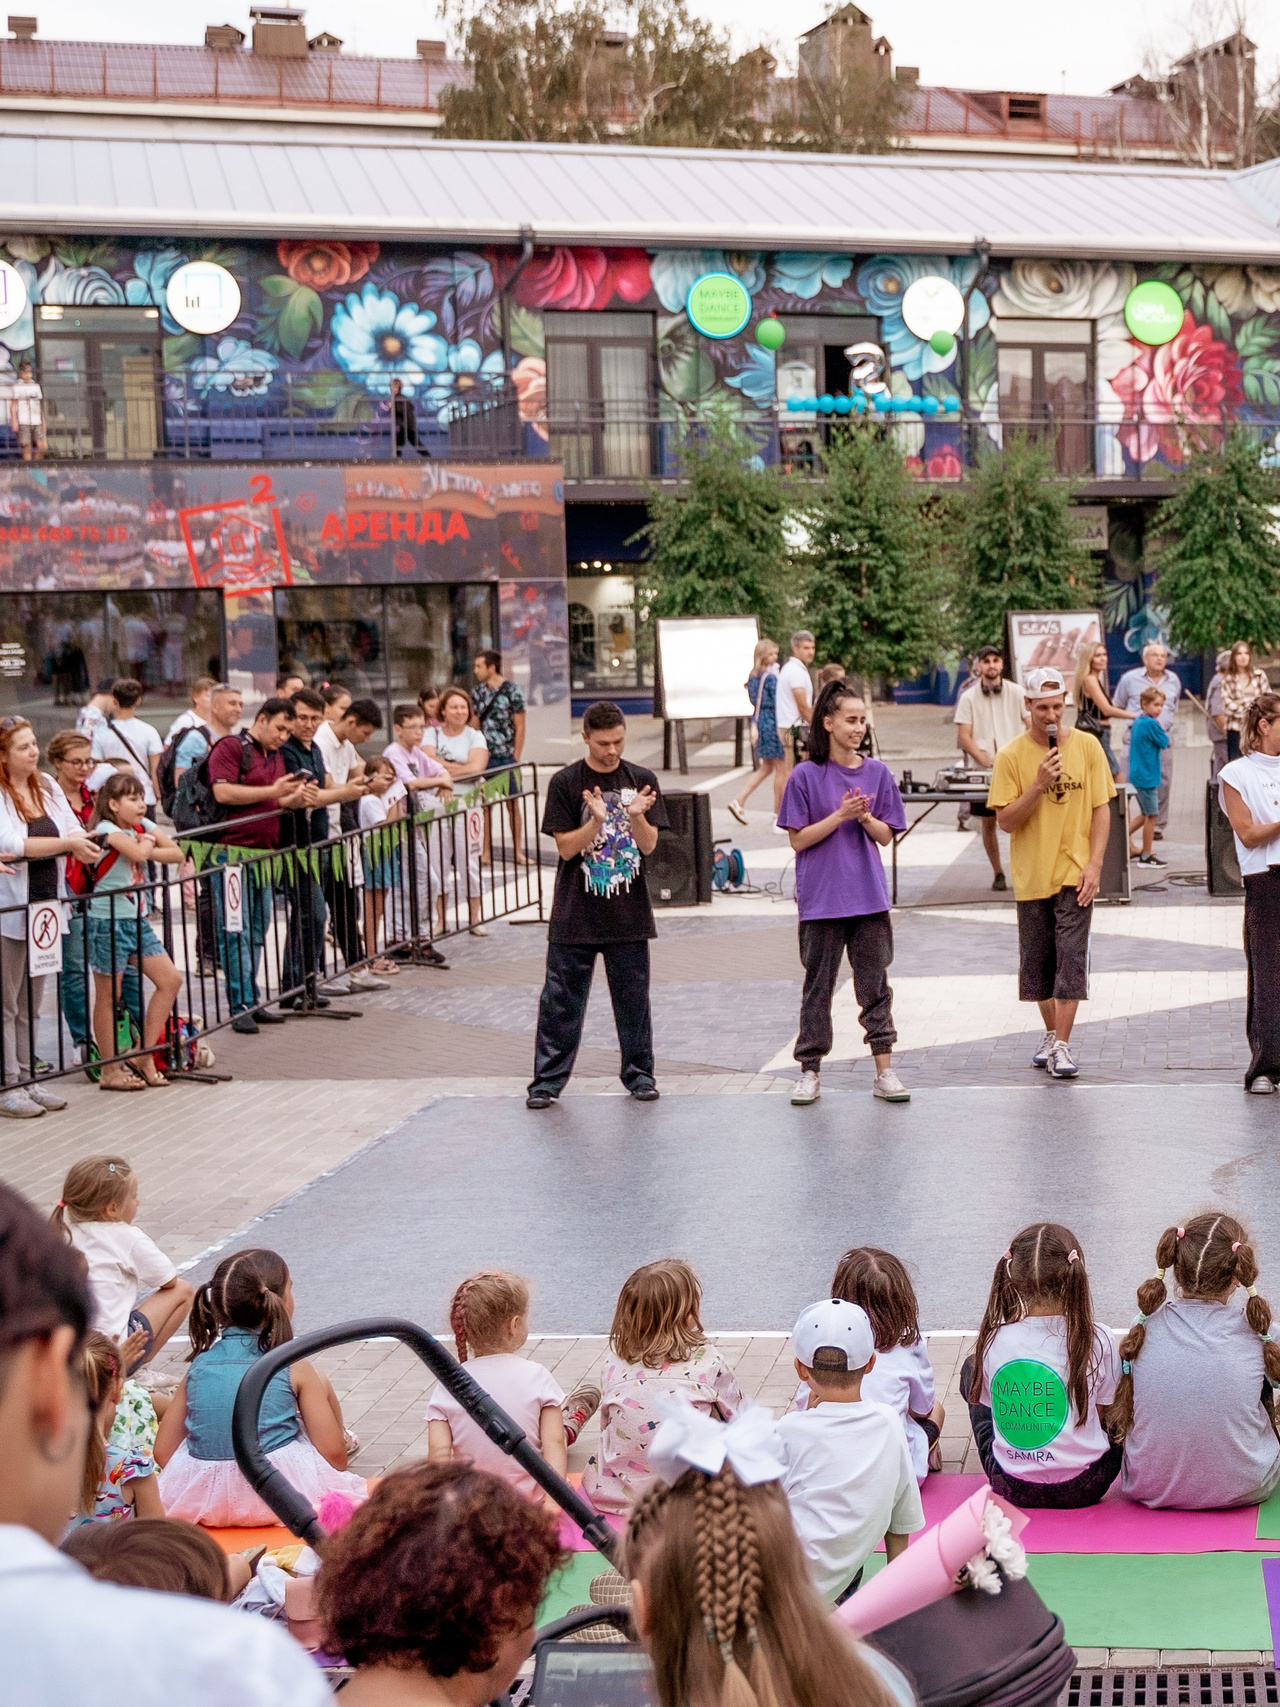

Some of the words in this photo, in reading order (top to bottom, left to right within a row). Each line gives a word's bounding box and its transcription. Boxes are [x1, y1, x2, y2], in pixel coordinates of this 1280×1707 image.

[320, 511, 470, 546] АРЕНДА
[996, 1381, 1055, 1397] MAYBE
[999, 1401, 1055, 1417] DANCE
[1000, 1421, 1055, 1431] COMMUNITY
[1006, 1449, 1055, 1462] SAMIRA
